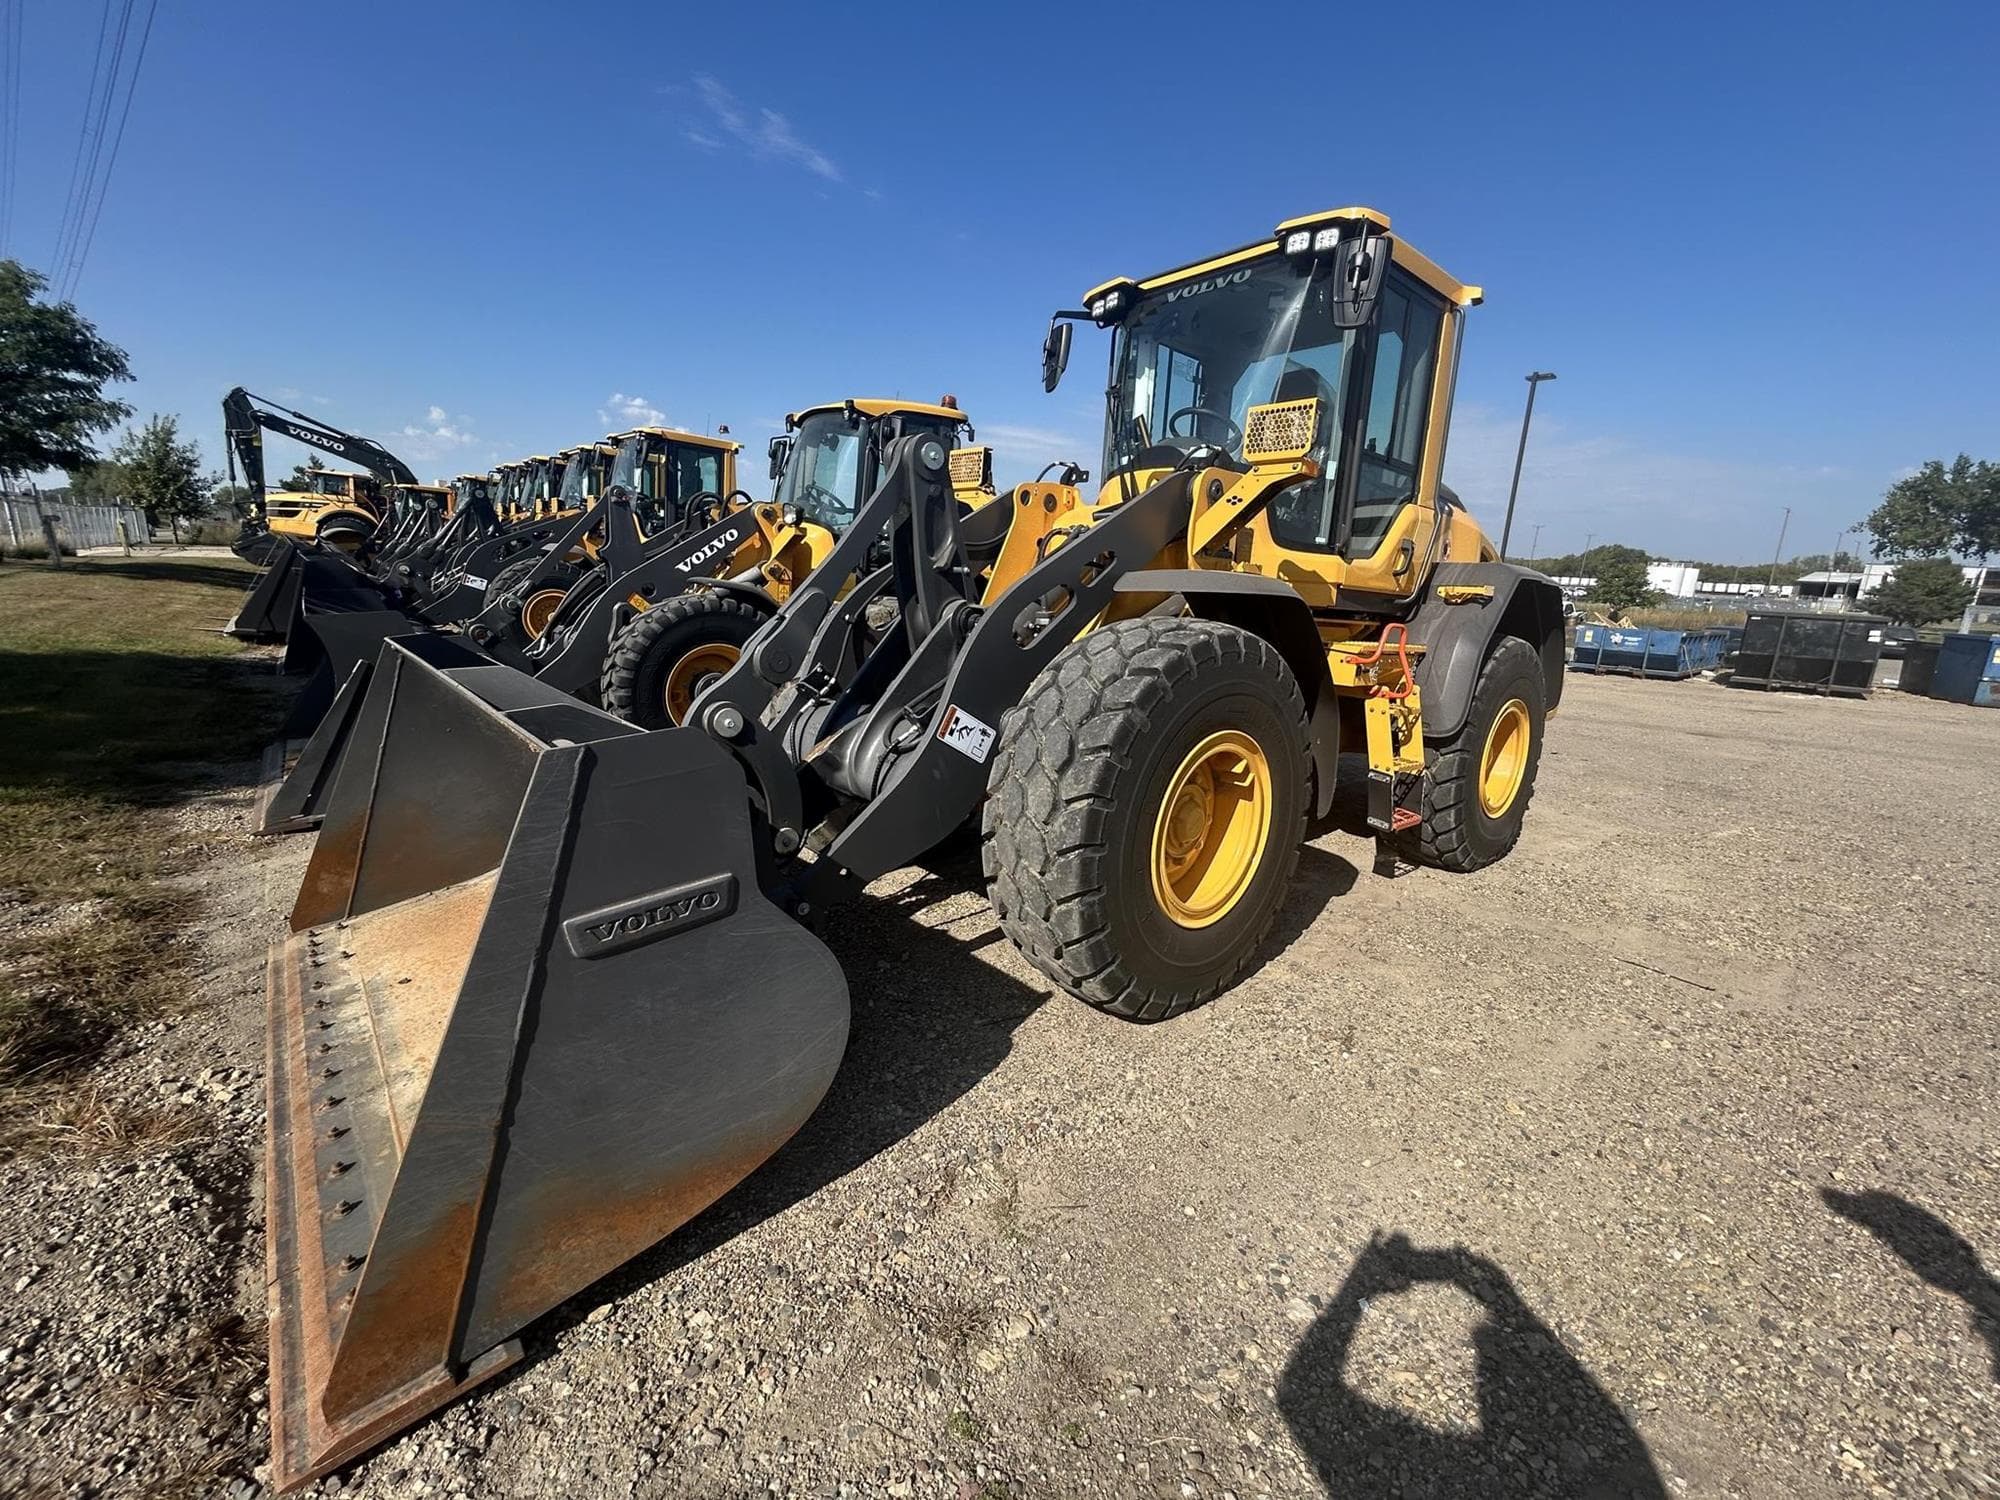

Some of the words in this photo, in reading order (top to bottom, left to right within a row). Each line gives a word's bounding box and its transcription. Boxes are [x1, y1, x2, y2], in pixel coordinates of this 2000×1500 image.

[1167, 269, 1252, 303] VOLVO
[286, 425, 345, 451] VOLVO
[674, 528, 739, 573] VOLVO
[585, 891, 721, 942] VOLVO
